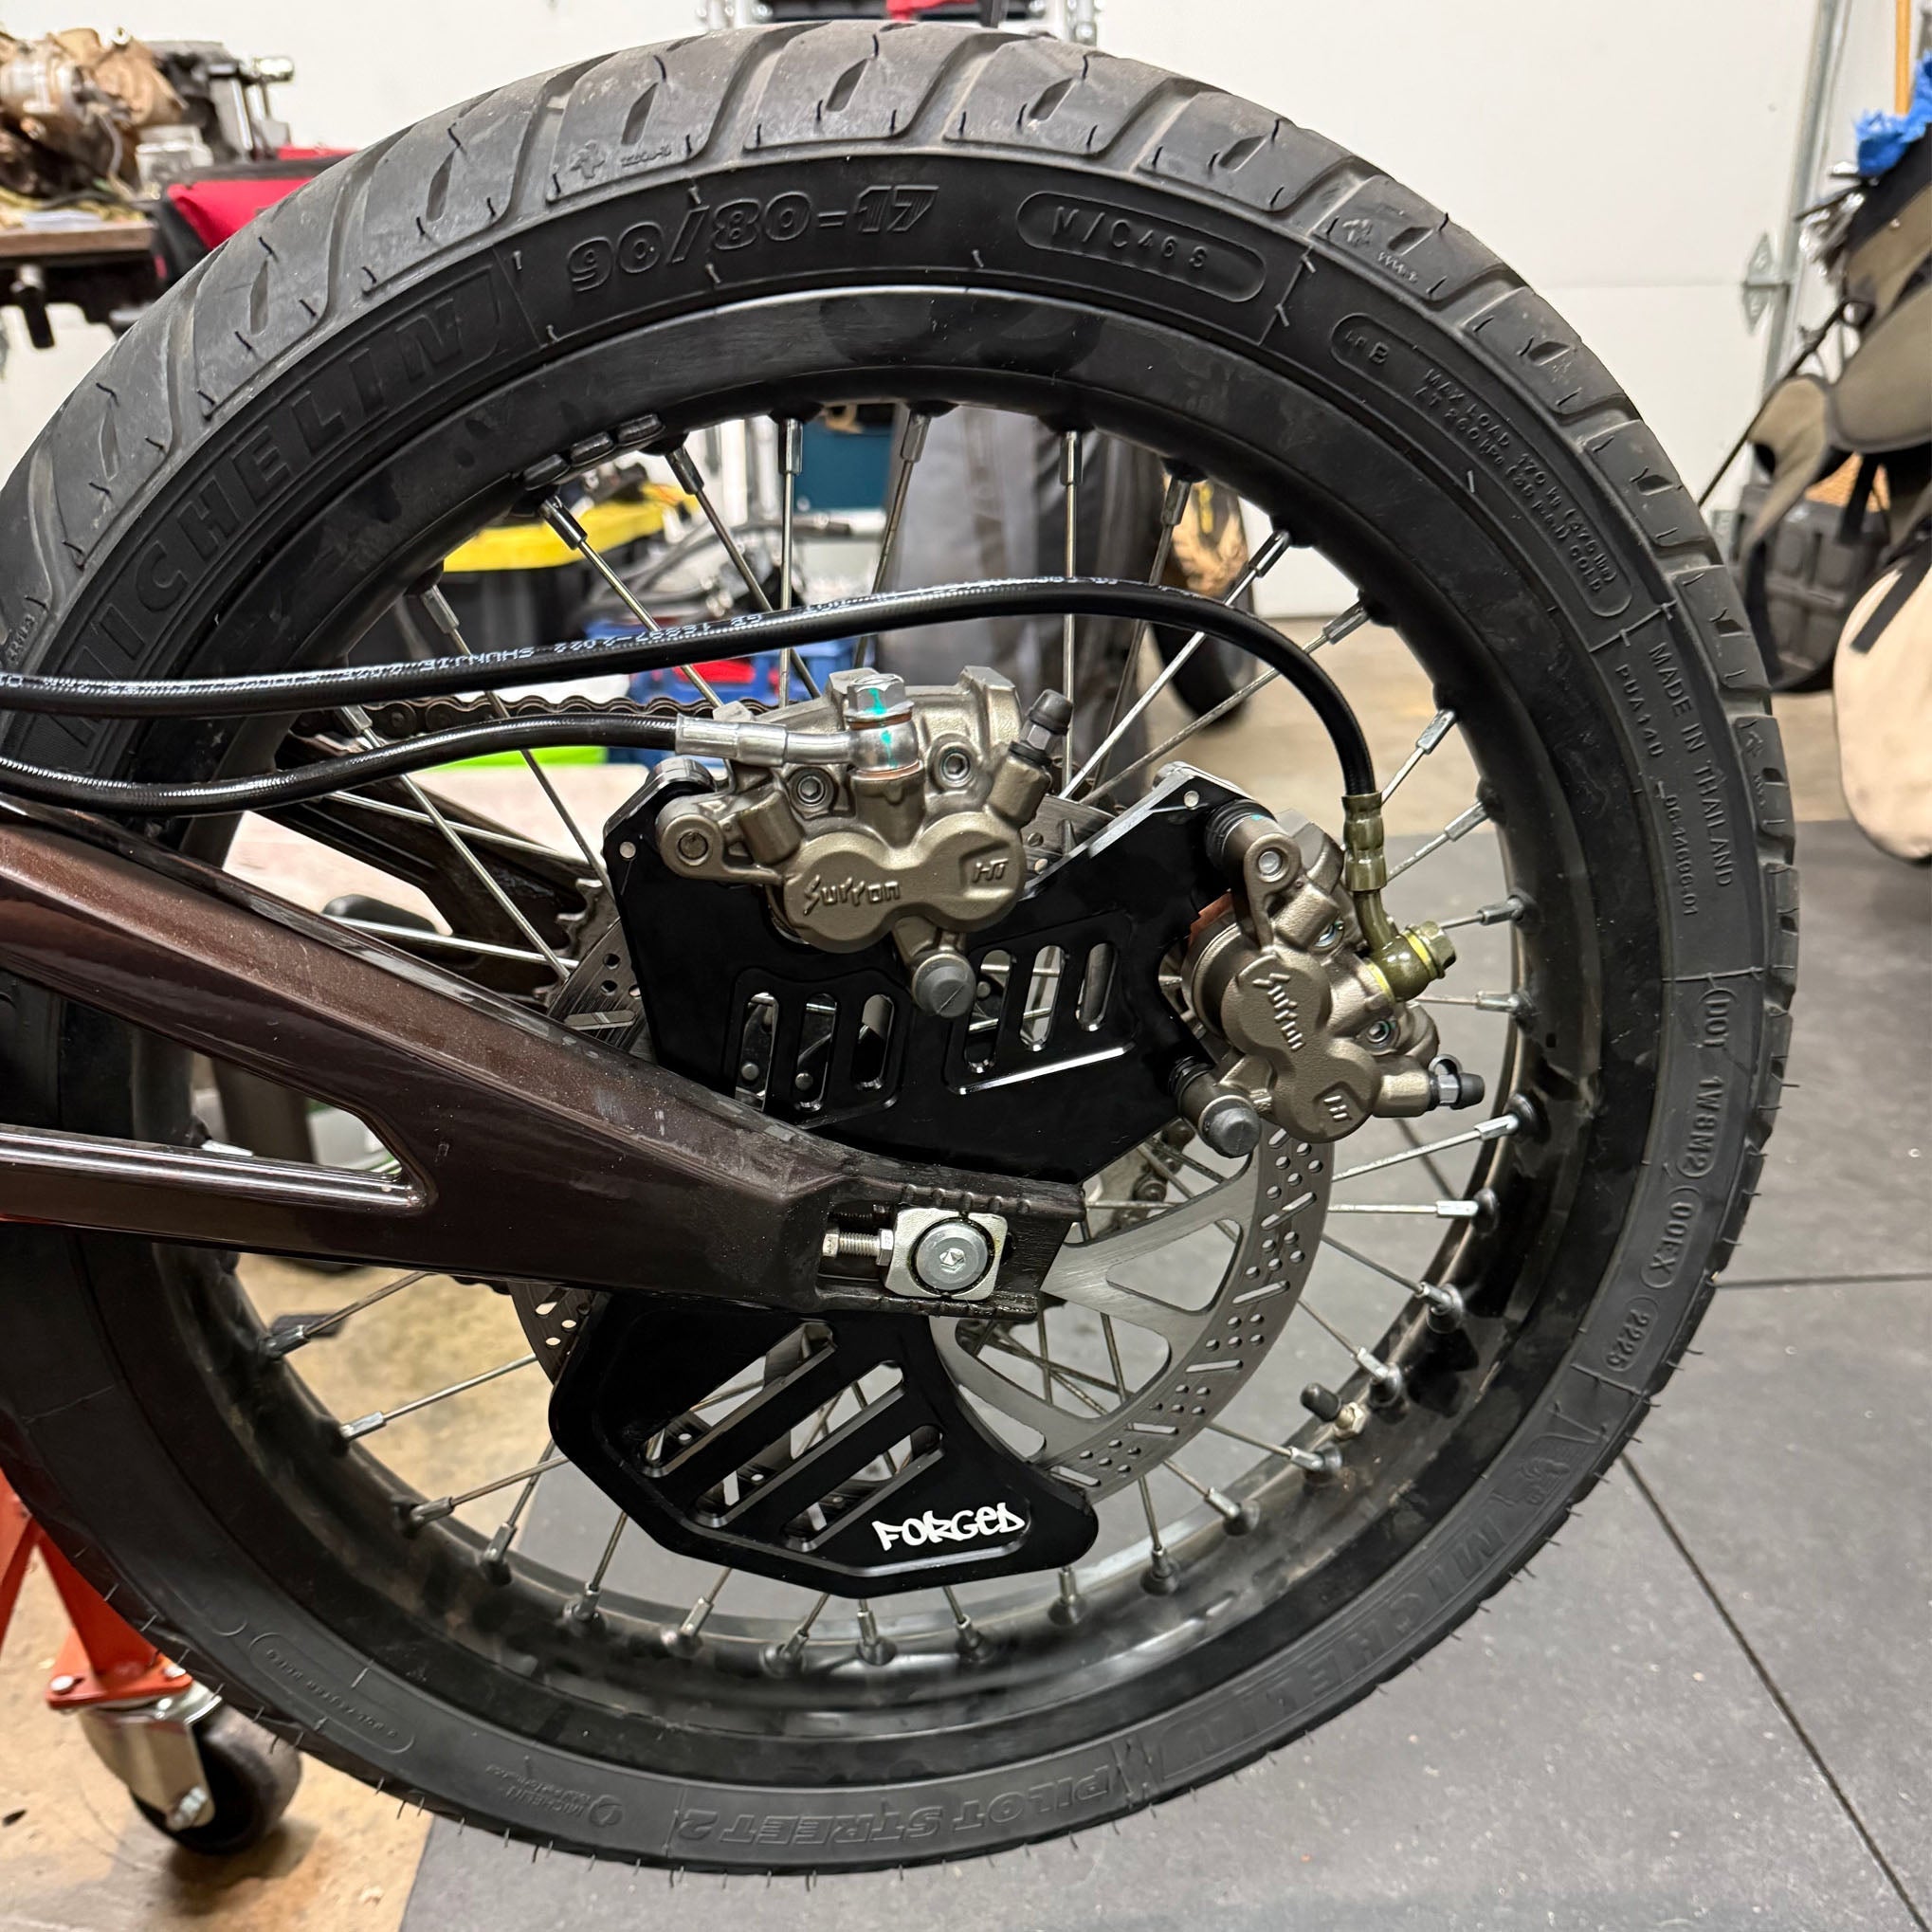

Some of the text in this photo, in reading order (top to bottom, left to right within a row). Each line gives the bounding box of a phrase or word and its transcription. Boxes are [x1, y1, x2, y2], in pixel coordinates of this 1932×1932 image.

[567, 186, 939, 292] 90/80-17
[1649, 642, 1734, 886] MADE IN THAILAND
[675, 1764, 1110, 1847] PILOT STREET 2
